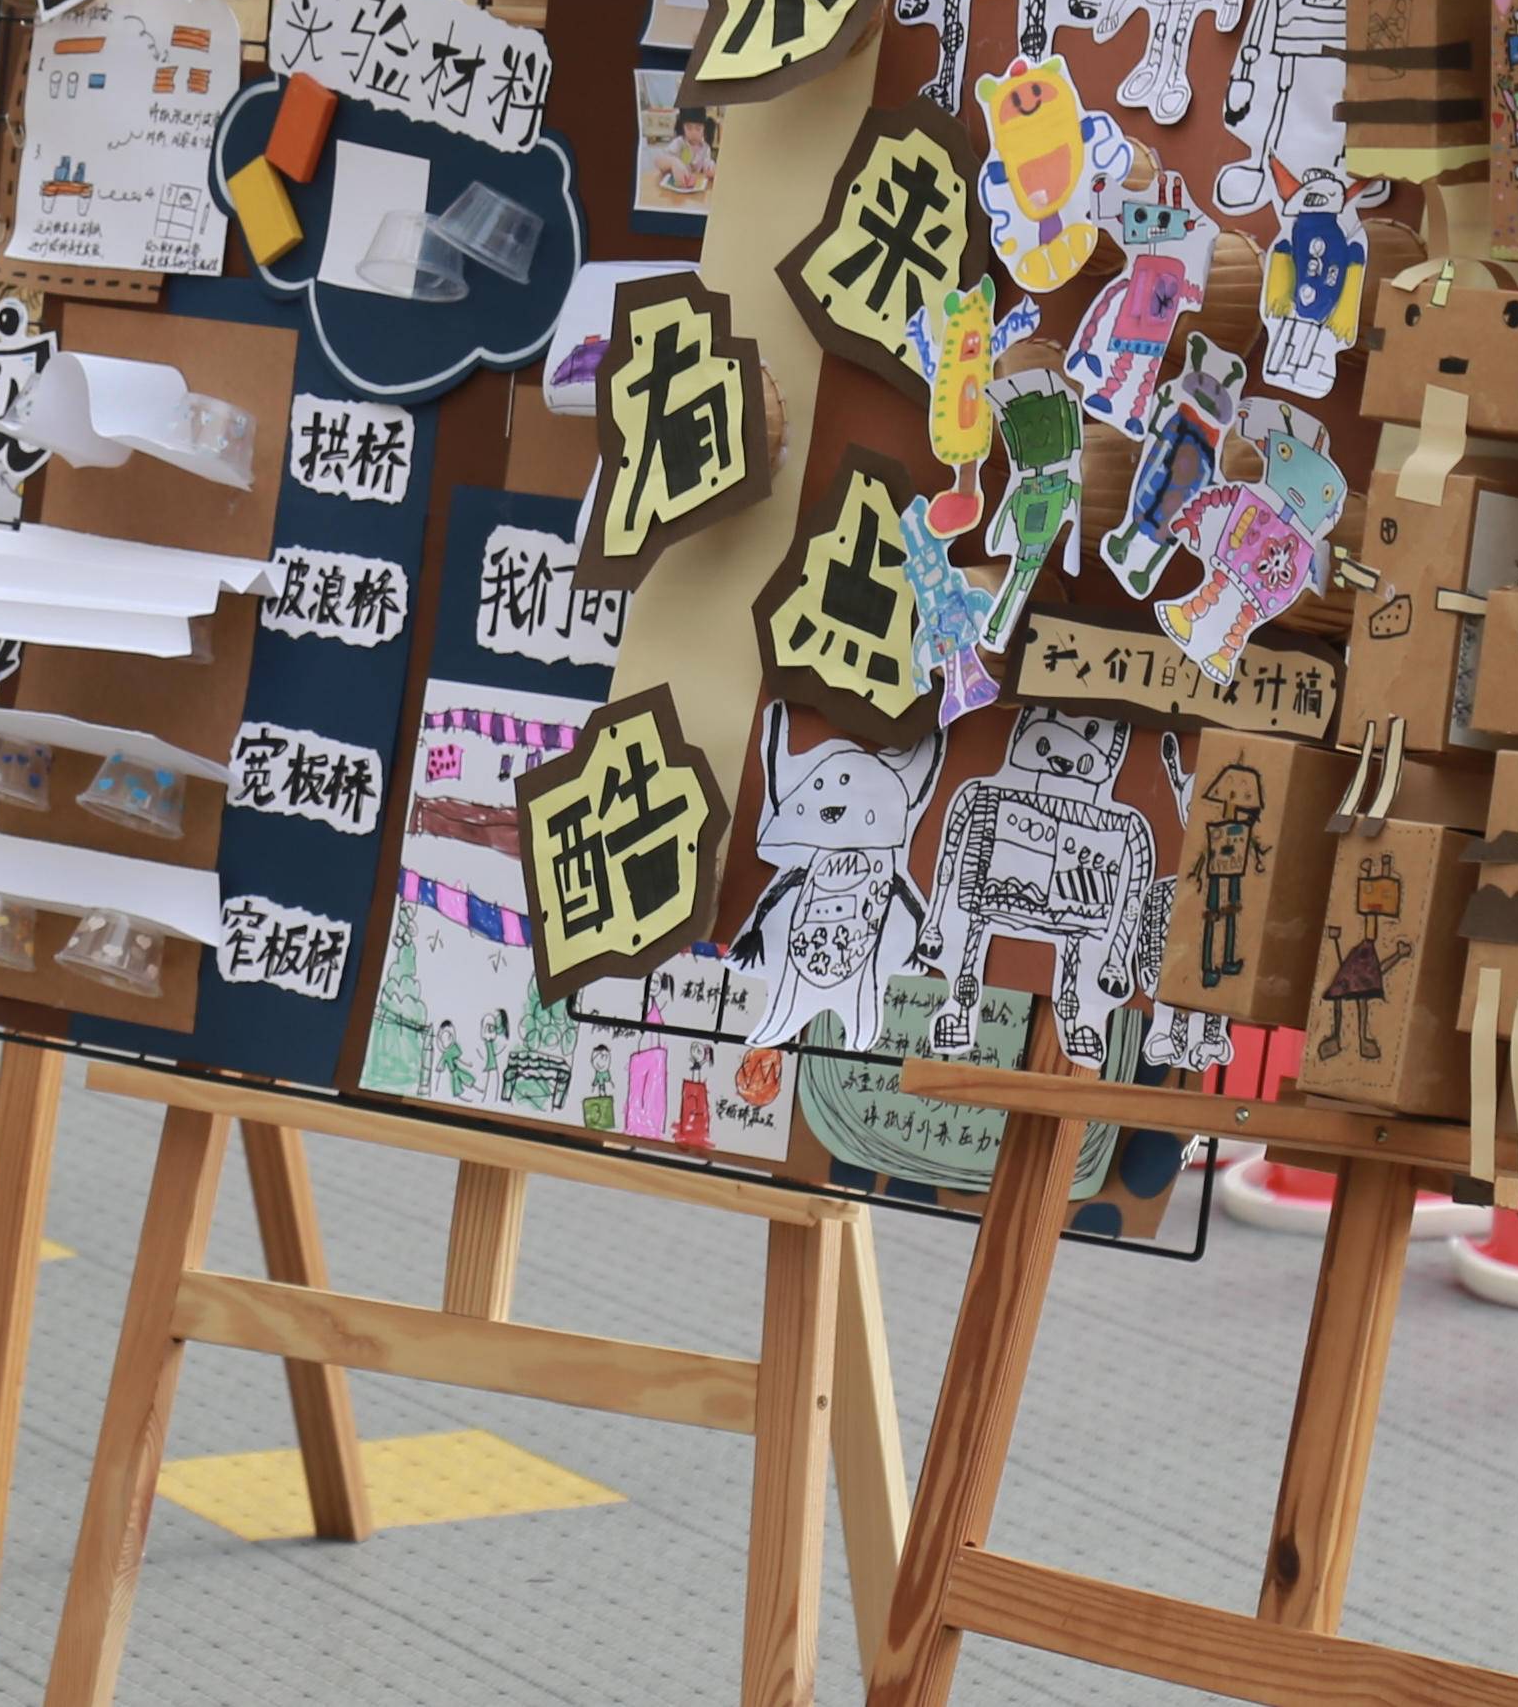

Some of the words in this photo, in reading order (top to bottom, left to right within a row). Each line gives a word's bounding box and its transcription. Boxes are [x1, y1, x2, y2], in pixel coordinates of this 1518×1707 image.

[298, 404, 411, 496] 拱桥
[266, 555, 401, 637] 波浪桥
[234, 728, 378, 829] 宽板桥
[221, 899, 351, 992] 窄板桥
